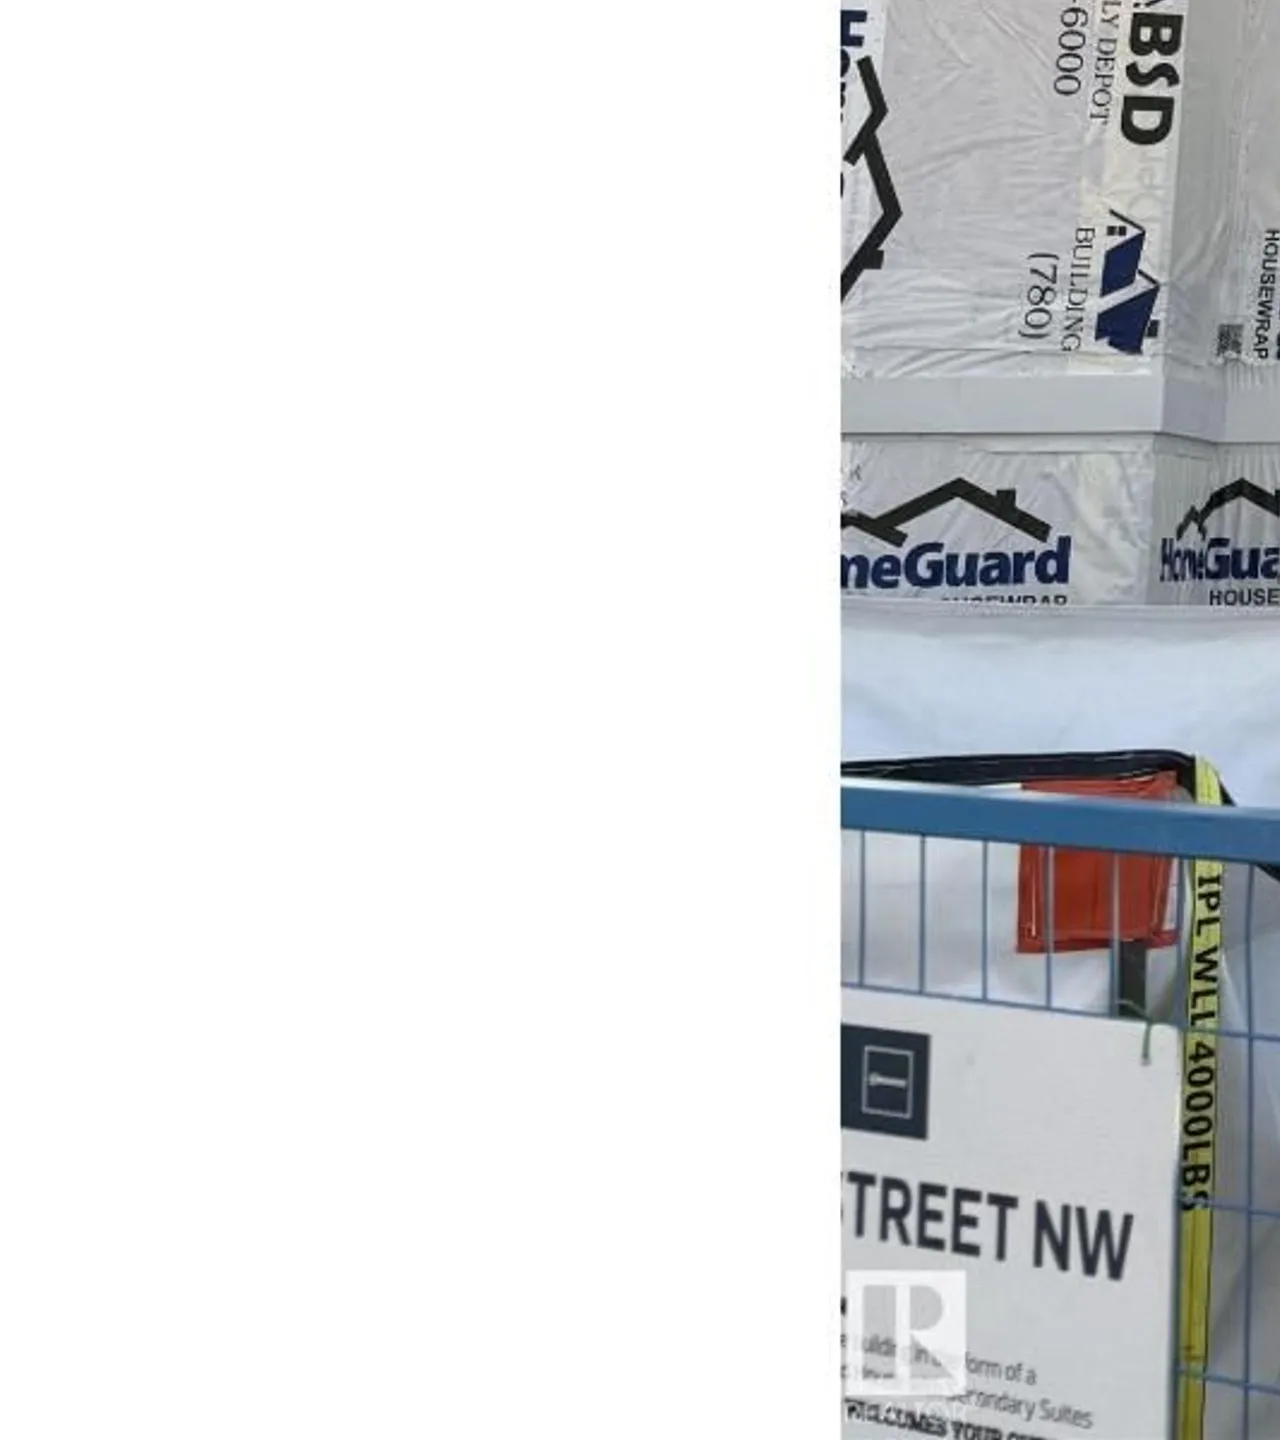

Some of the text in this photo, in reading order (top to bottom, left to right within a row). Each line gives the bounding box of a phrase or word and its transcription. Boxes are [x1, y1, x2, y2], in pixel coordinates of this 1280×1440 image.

[1090, 32, 1118, 125] DEPOT
[1121, 11, 1184, 146] BSD
[1018, 252, 1058, 340] (780)
[1060, 226, 1096, 352] BUILDING
[1252, 229, 1280, 361] HOUSEWRAP
[1189, 945, 1219, 1028] WLL
[1180, 1040, 1216, 1211] 4000LBS
[841, 1170, 1134, 1282] TREET NW
